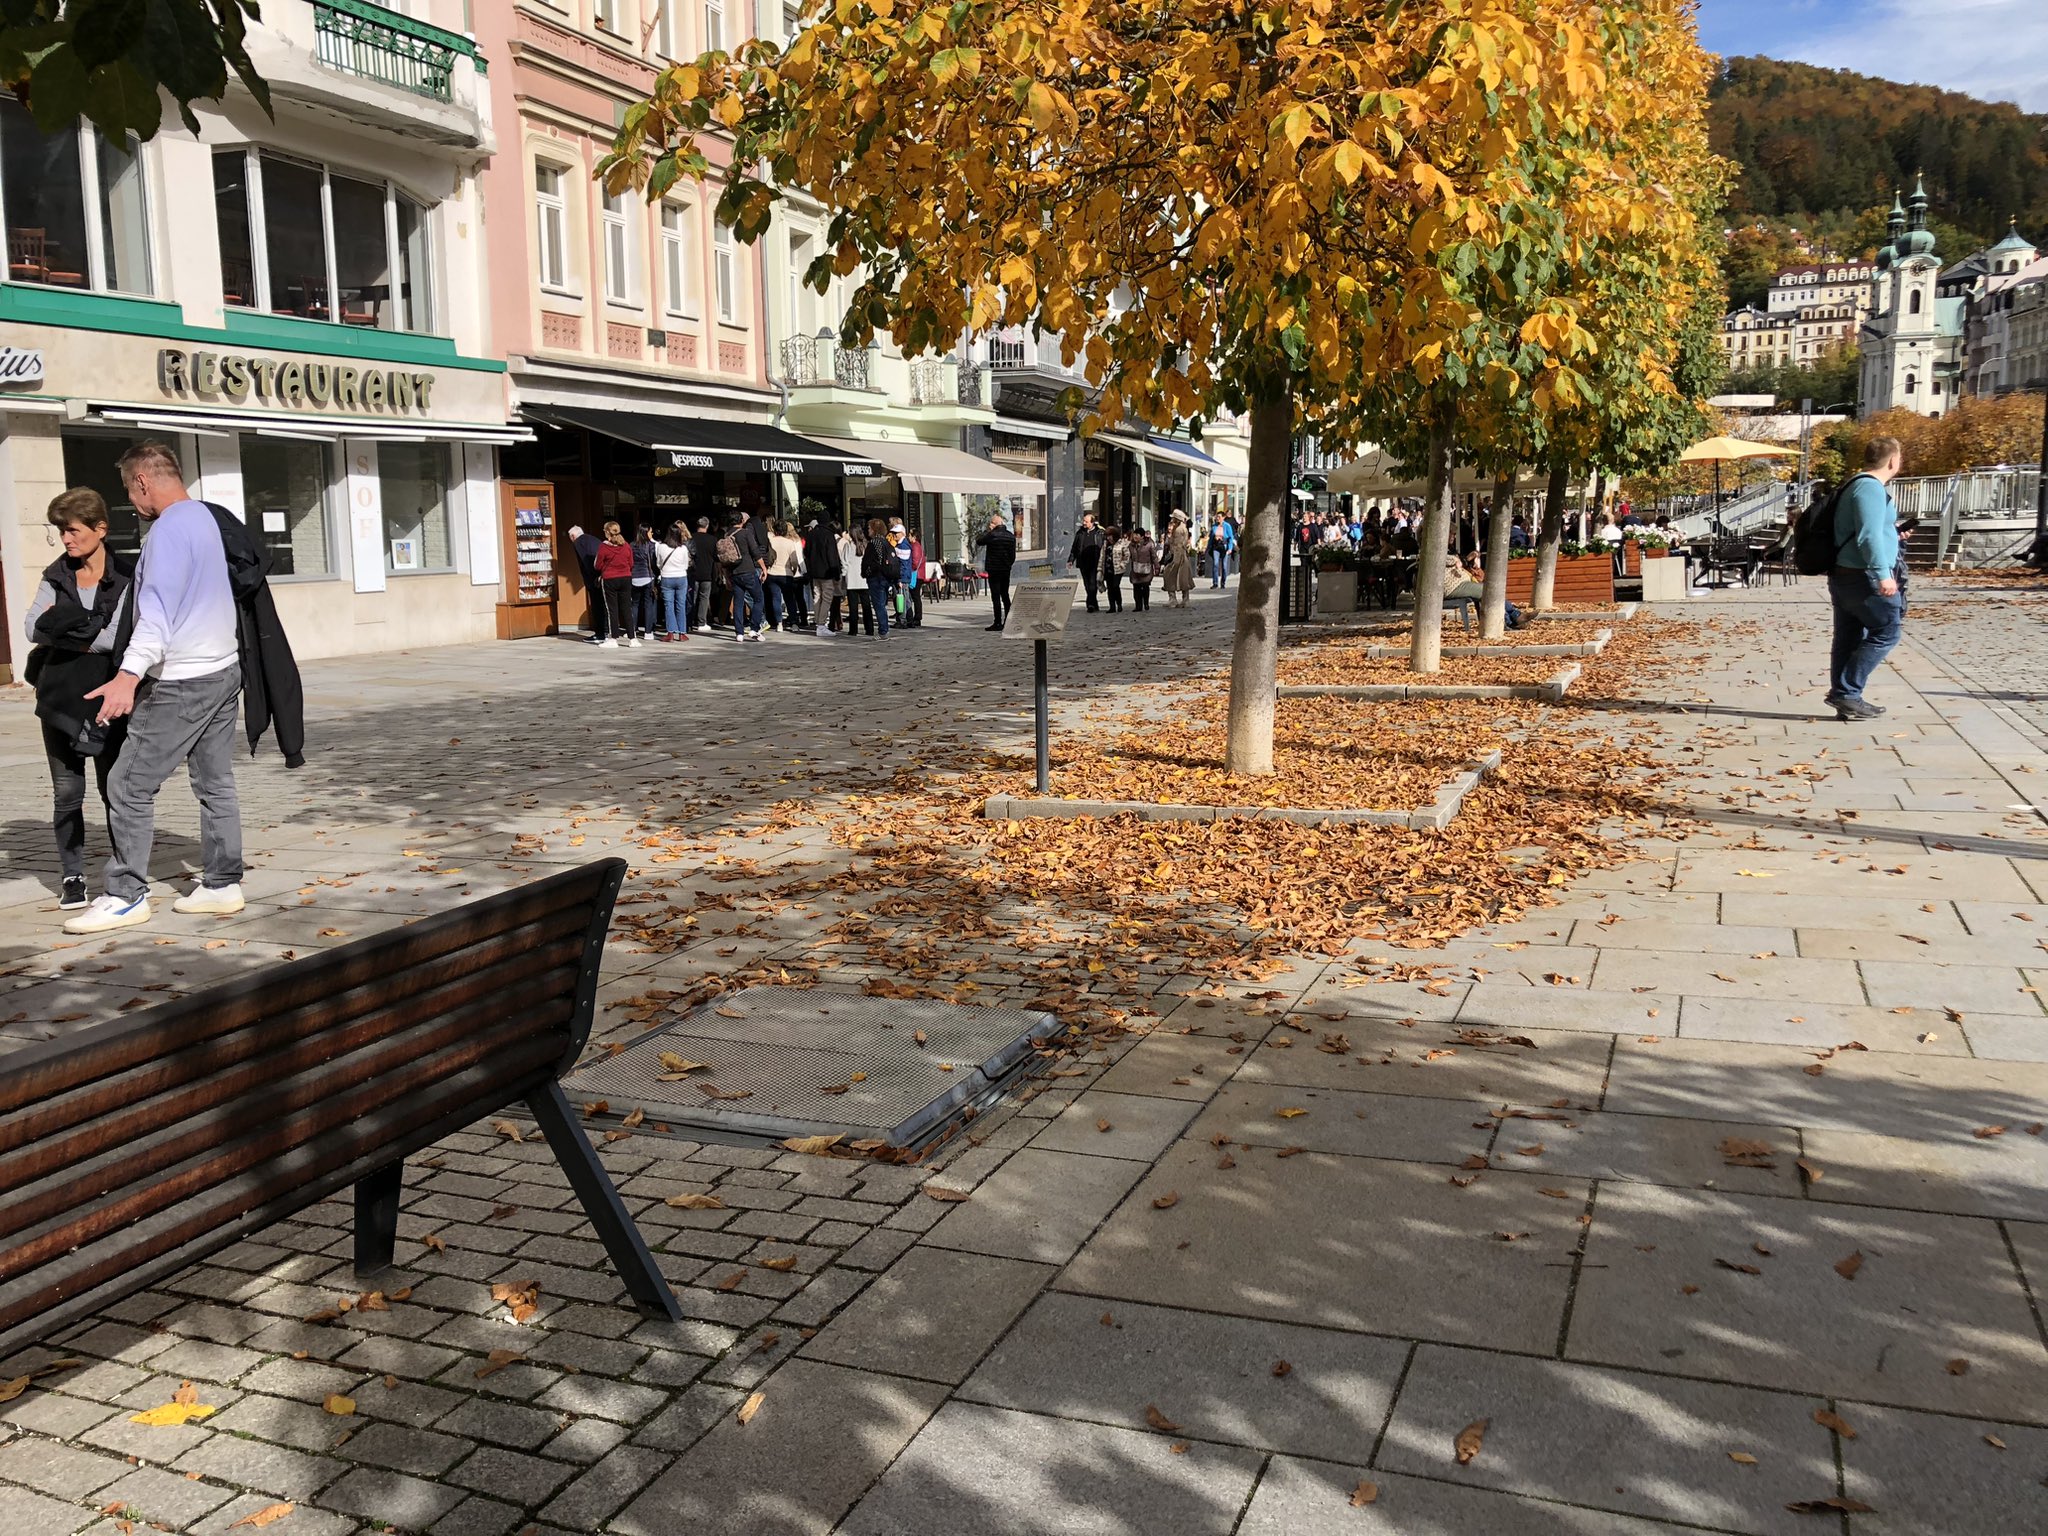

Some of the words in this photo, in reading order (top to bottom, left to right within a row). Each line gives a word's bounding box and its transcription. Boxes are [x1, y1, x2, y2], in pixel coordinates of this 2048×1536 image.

[158, 349, 435, 409] RESTAURANT
[761, 459, 768, 471] U
[770, 457, 804, 473] JÁCHYMA
